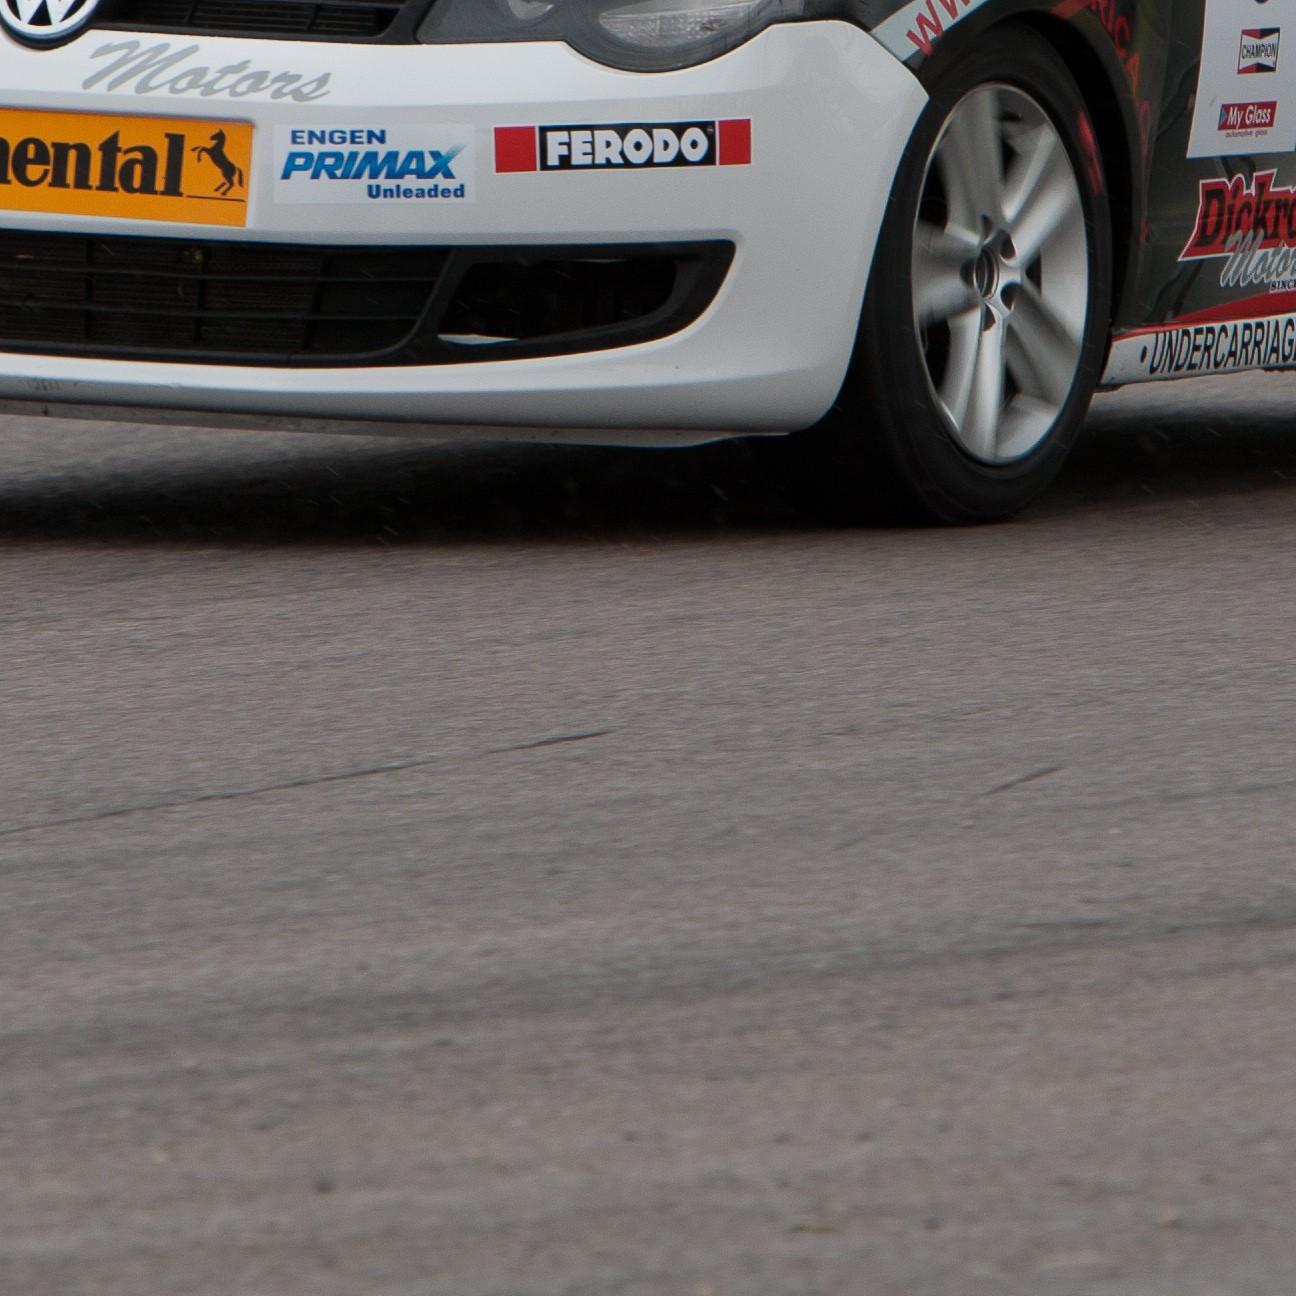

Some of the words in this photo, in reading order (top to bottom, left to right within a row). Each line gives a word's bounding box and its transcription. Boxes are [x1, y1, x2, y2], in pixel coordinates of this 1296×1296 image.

[1240, 41, 1278, 60] CHAMPION
[79, 40, 334, 103] Motors
[1226, 105, 1244, 130] My
[1244, 104, 1272, 126] Glass
[290, 129, 386, 146] ENGEN
[545, 127, 710, 167] FERODO
[280, 143, 465, 181] PRIMAX
[366, 183, 466, 200] Unleaded
